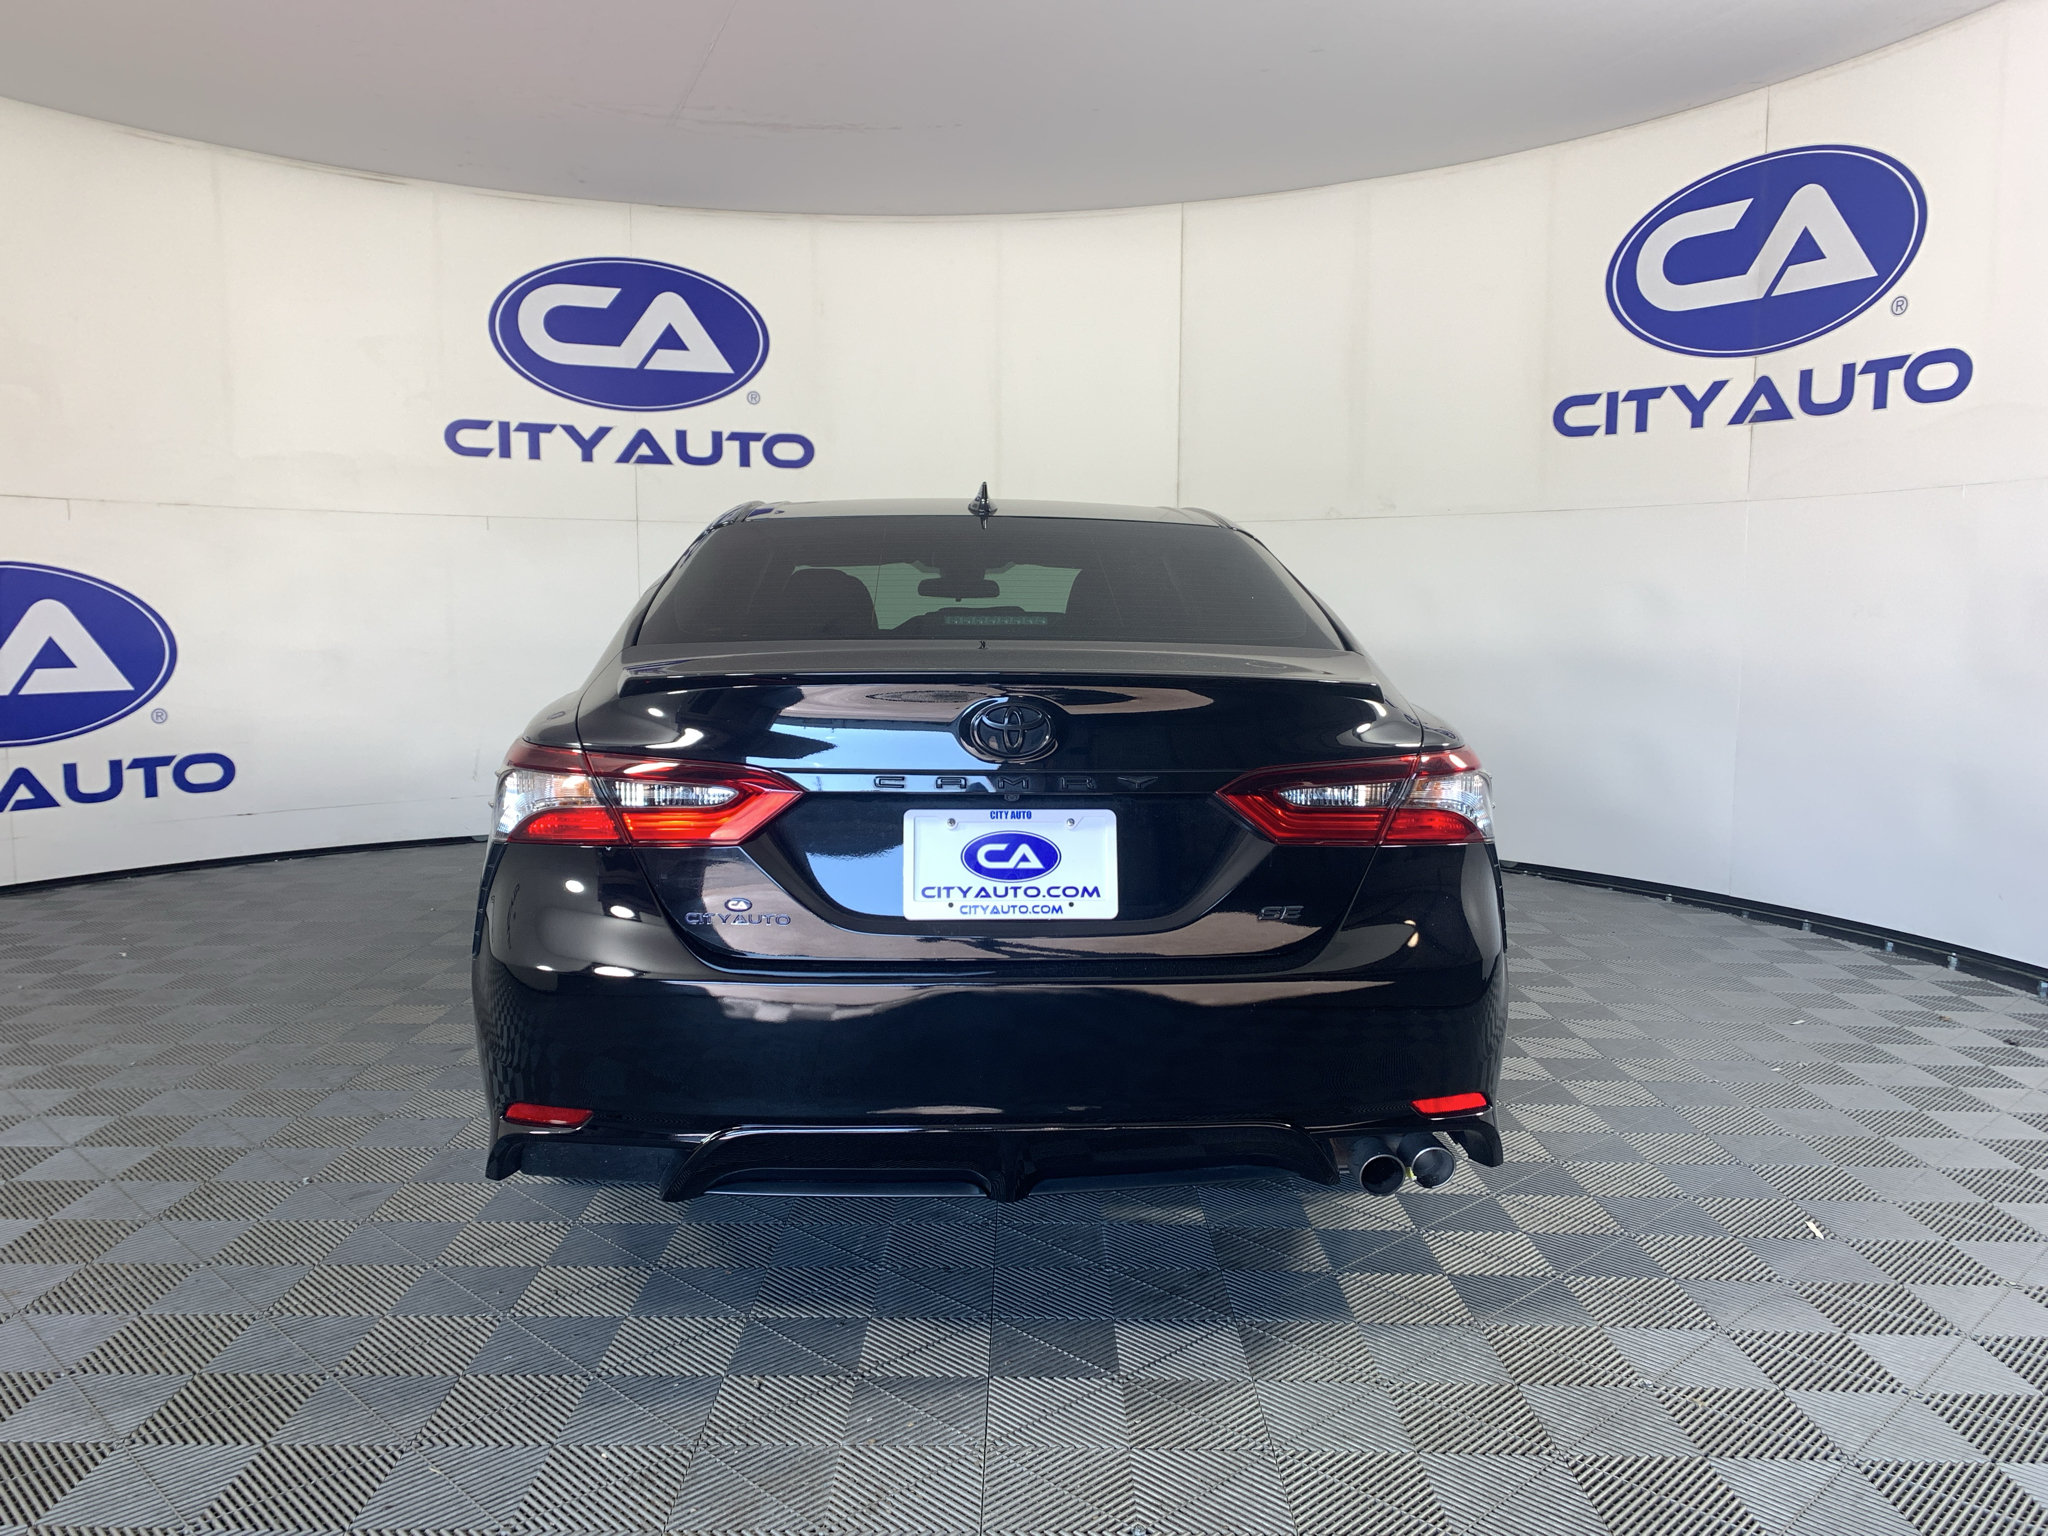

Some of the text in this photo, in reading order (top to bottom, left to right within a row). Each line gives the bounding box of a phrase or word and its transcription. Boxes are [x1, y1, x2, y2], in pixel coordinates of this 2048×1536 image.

[1636, 183, 1879, 312] CA
[517, 283, 736, 375] CA
[0, 752, 236, 813] AUTO
[873, 775, 1159, 790] CAMRY
[989, 810, 1032, 820] CITY AUTO
[976, 843, 1045, 869] CA
[921, 886, 1101, 899] CITYAUTO.COM
[960, 904, 1064, 915] CITYAUTO.COM
[1258, 905, 1304, 920] SE
